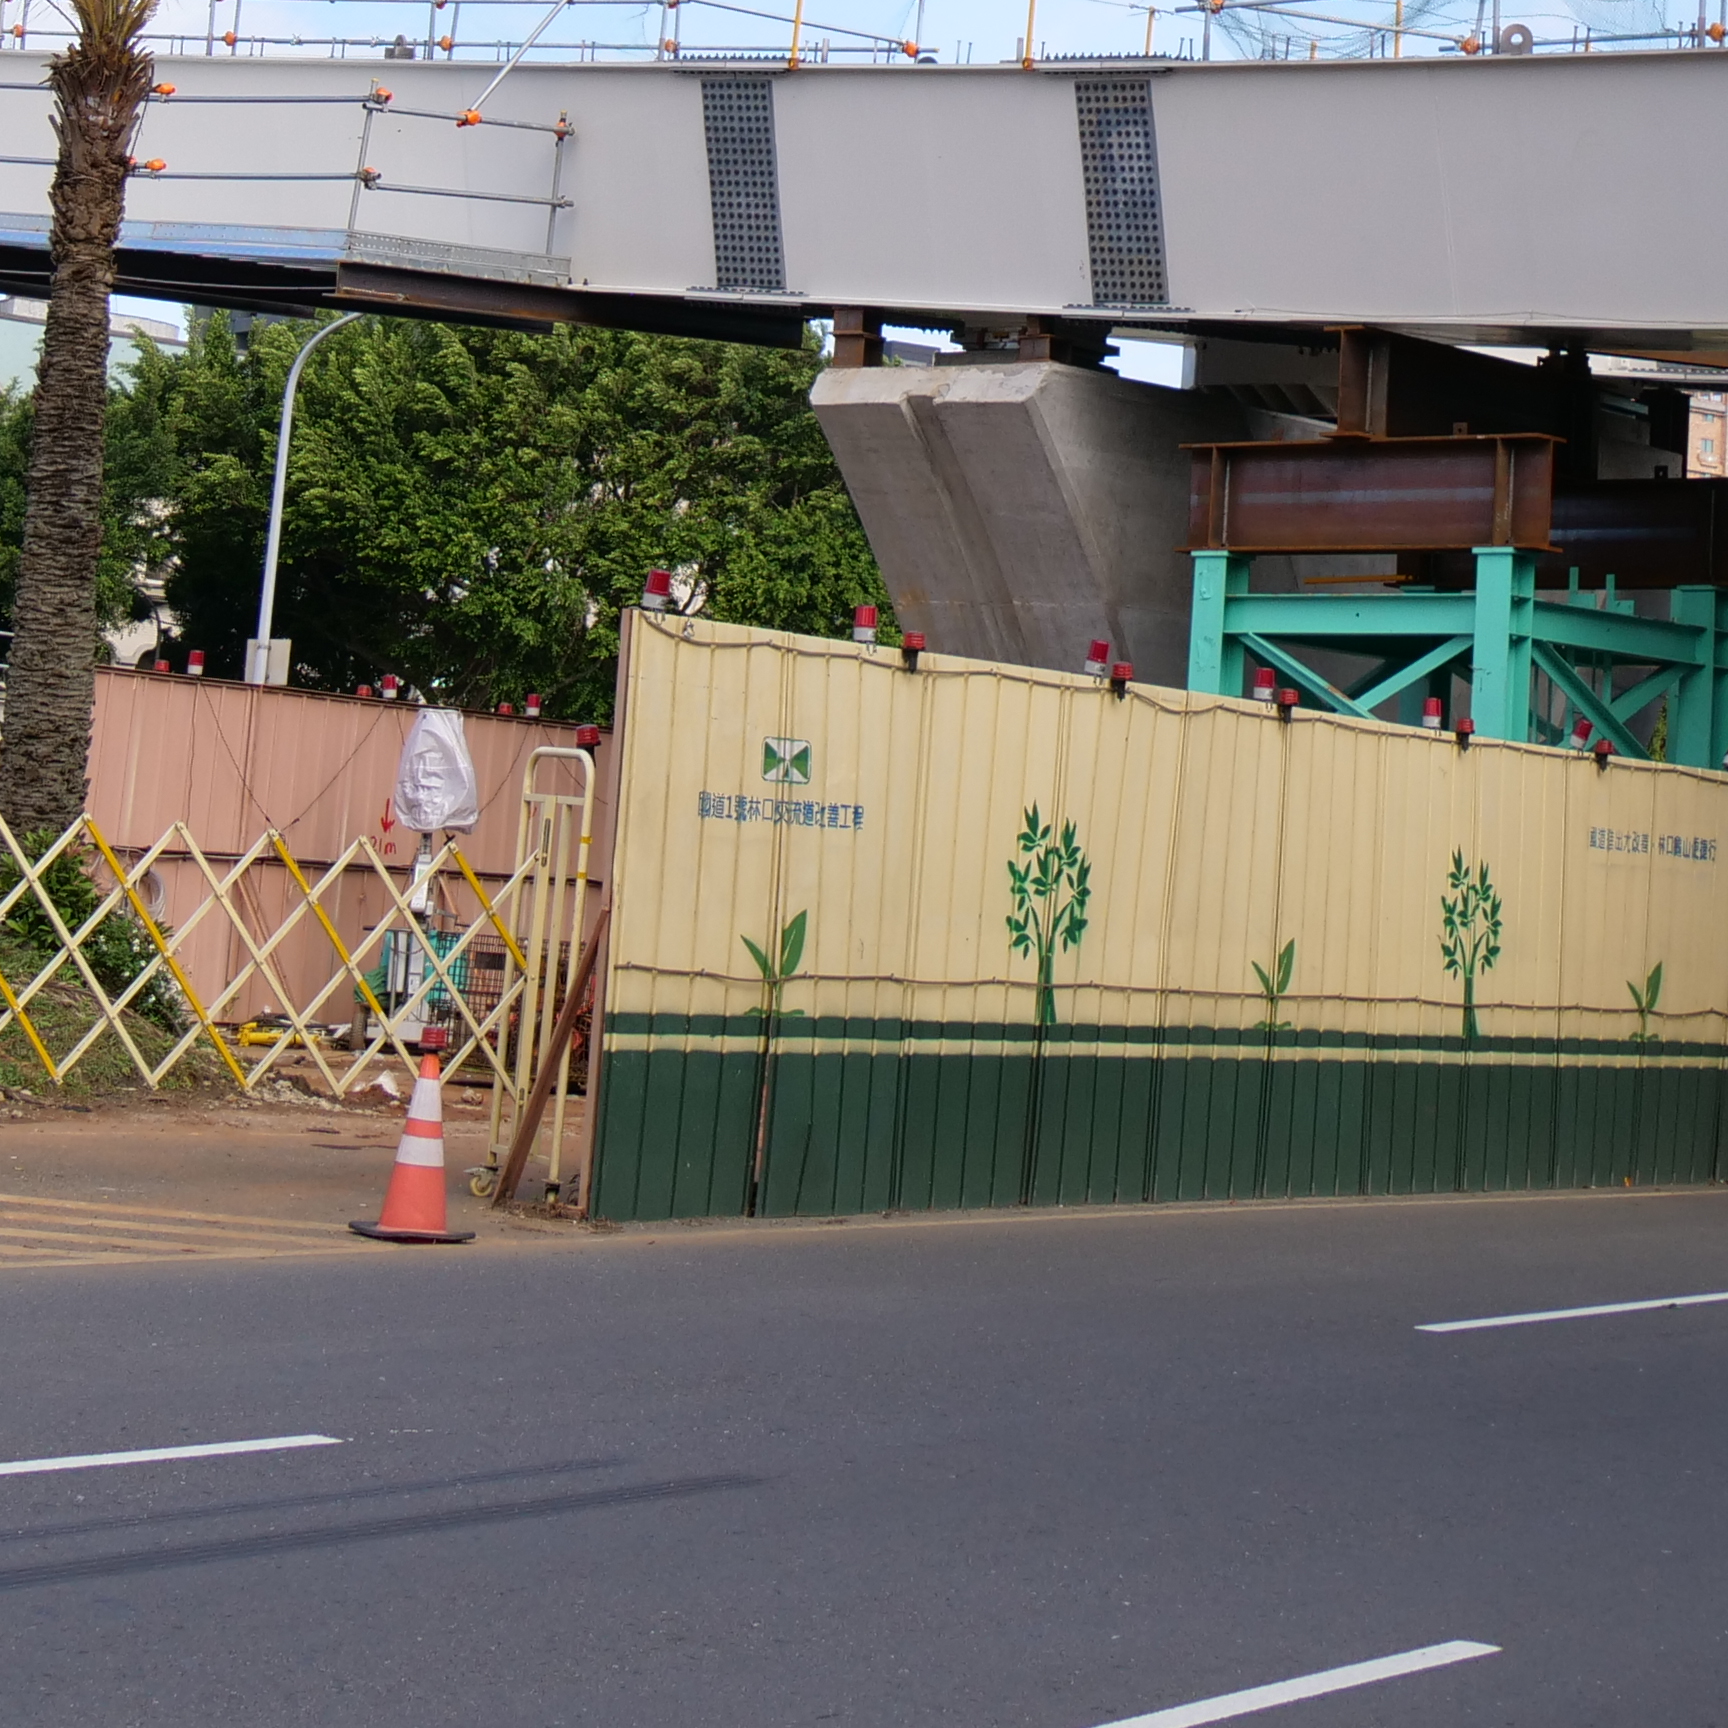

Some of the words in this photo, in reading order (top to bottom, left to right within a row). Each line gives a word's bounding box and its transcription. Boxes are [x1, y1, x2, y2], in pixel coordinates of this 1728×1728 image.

[698, 790, 865, 830] 國道1號林口交流道改善工程
